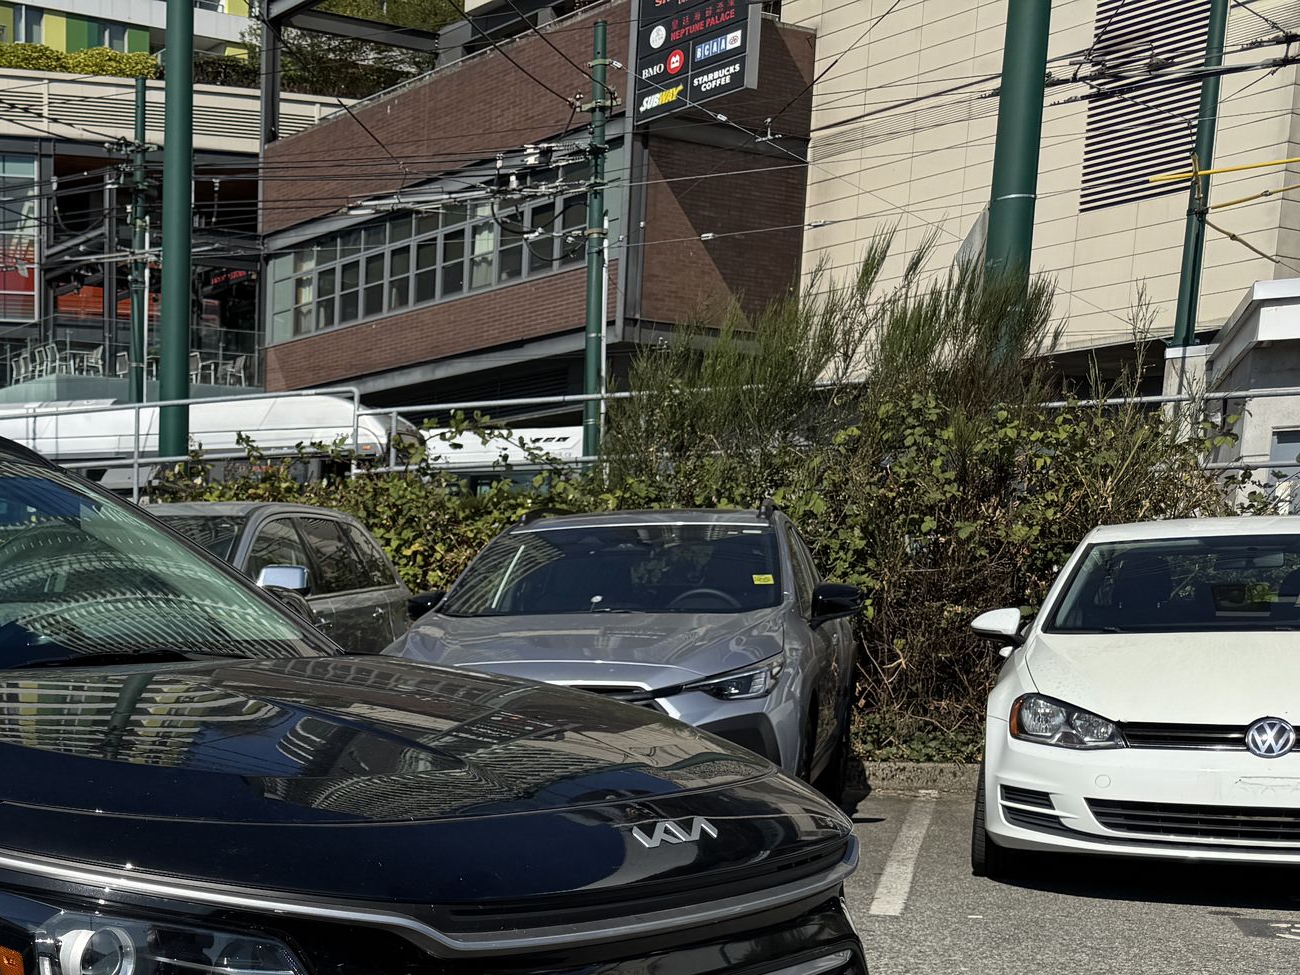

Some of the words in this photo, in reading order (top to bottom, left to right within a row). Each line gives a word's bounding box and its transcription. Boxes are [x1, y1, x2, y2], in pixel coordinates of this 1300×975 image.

[670, 20, 705, 41] NEPTUNE
[705, 9, 735, 28] PALACE
[696, 39, 726, 59] BCAA
[642, 63, 665, 79] BMO
[693, 63, 740, 87] STARBUCKS
[701, 75, 731, 92] COFFEE
[640, 84, 684, 112] SUBWAY
[631, 816, 718, 848] KIA
